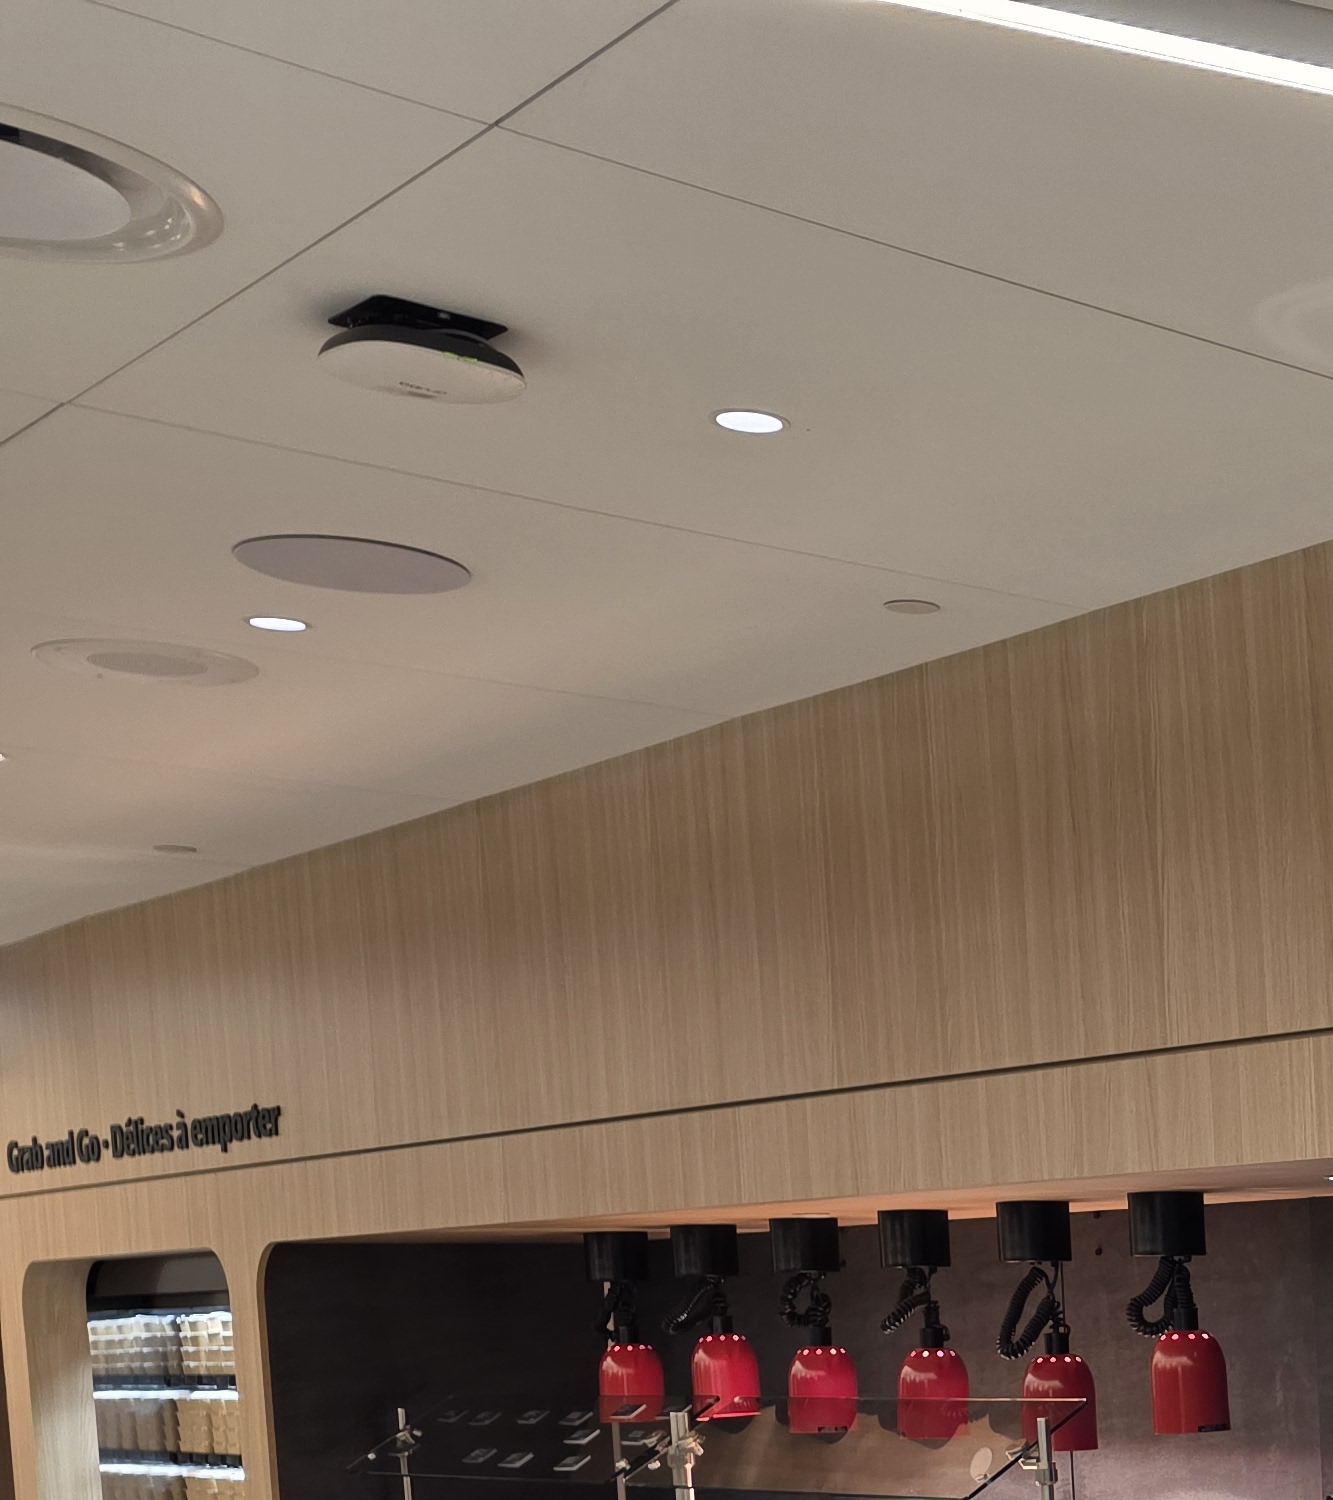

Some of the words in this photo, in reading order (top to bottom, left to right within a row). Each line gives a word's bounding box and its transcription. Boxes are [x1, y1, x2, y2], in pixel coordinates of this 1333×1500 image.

[7, 1135, 44, 1173] Grab
[45, 1129, 76, 1169] and
[77, 1128, 101, 1163] Go
[110, 1117, 174, 1158] Délices
[175, 1109, 189, 1150] à
[190, 1103, 282, 1153] emporter
